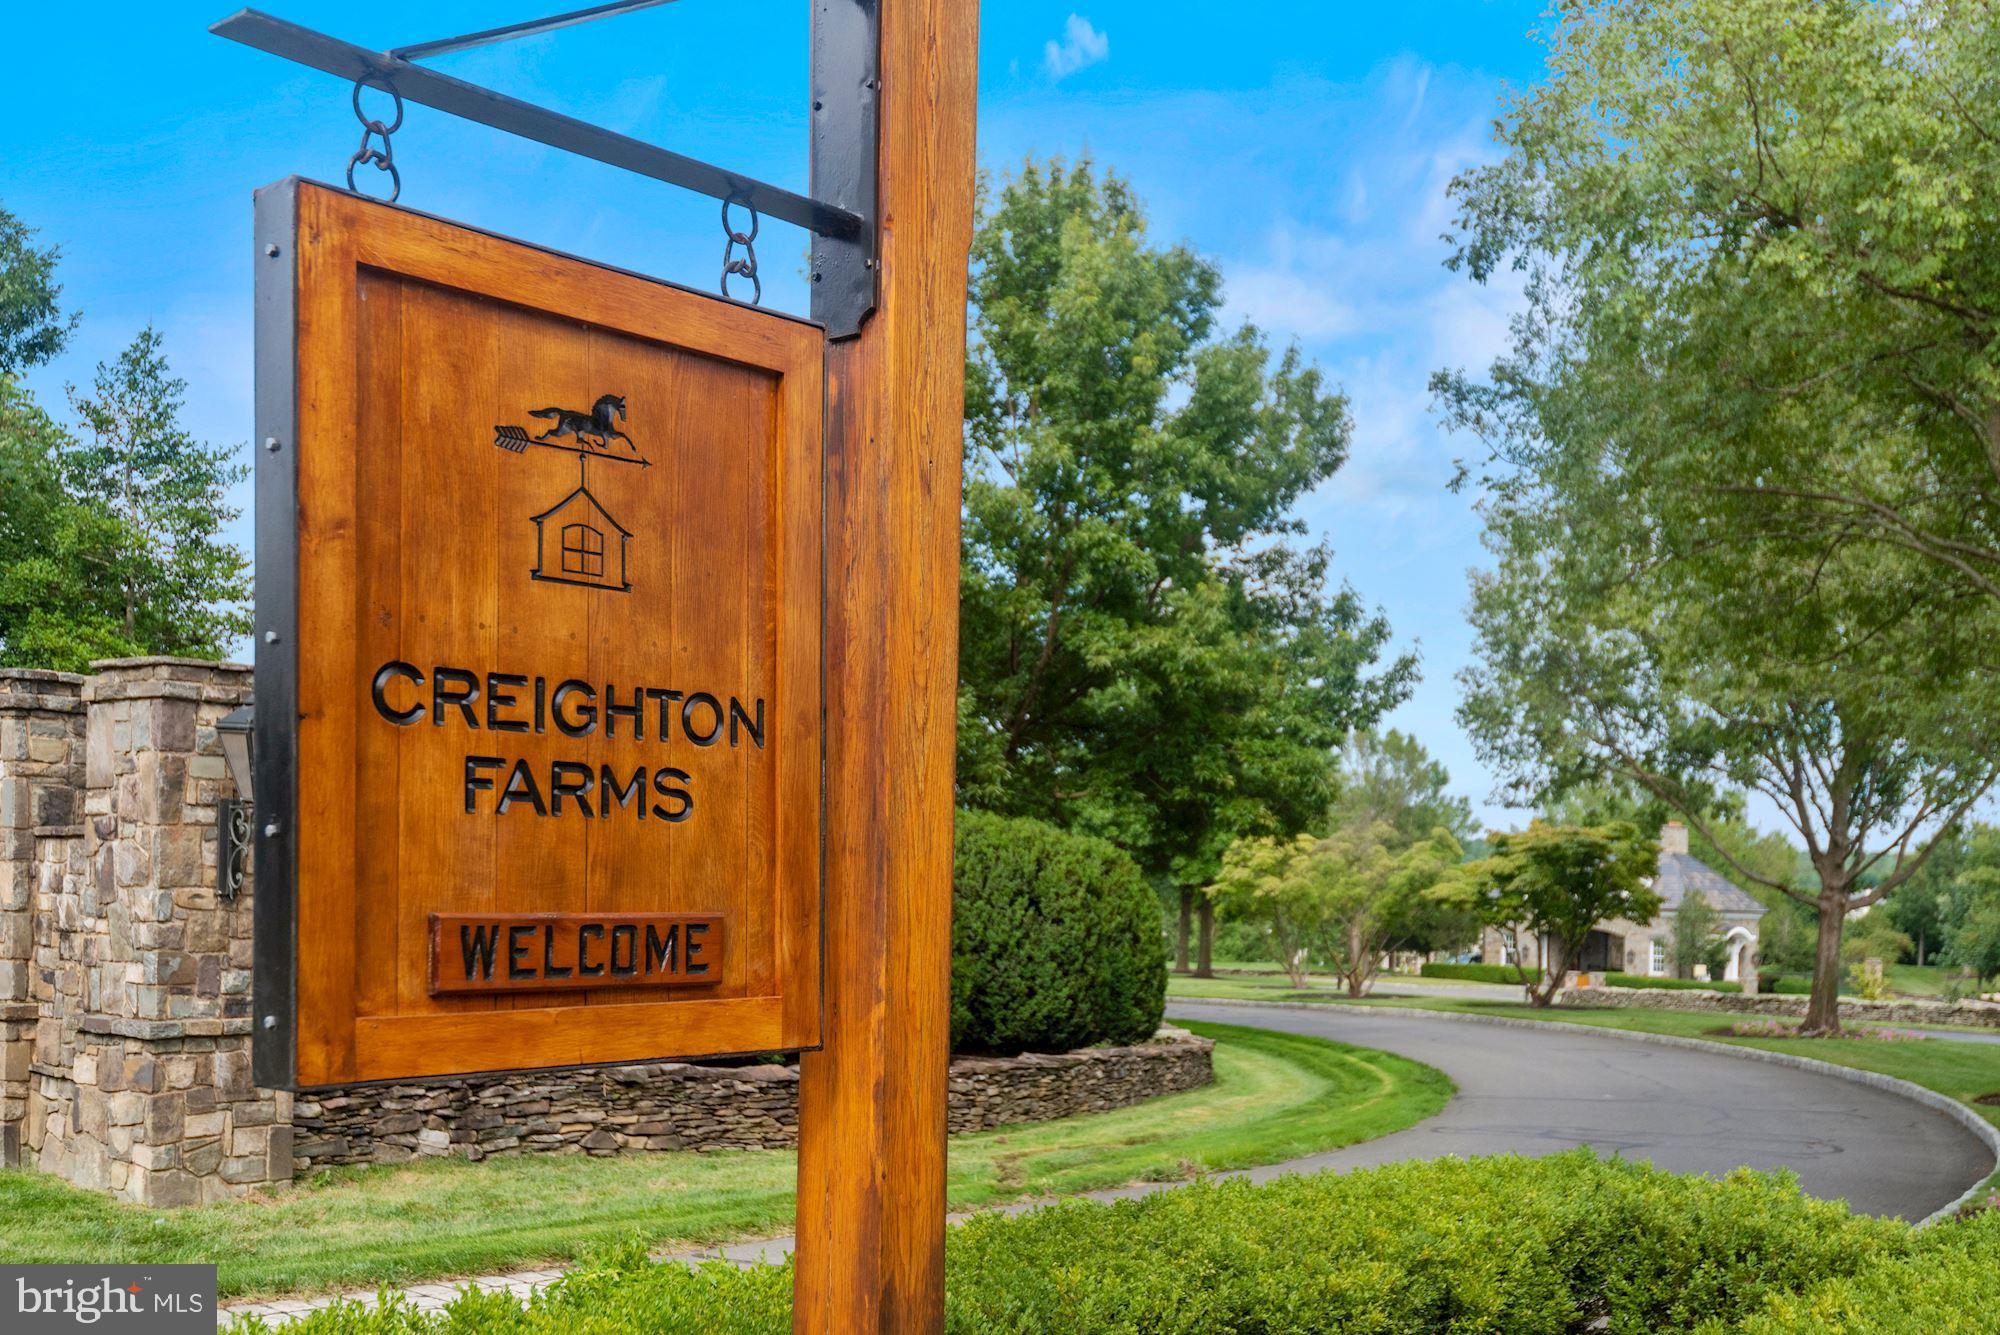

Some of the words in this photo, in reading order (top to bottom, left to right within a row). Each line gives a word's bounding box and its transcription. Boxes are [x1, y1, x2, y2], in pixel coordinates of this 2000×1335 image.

[372, 660, 765, 749] CREIGHTON
[465, 755, 695, 823] FARMS
[460, 923, 711, 982] WELCOME
